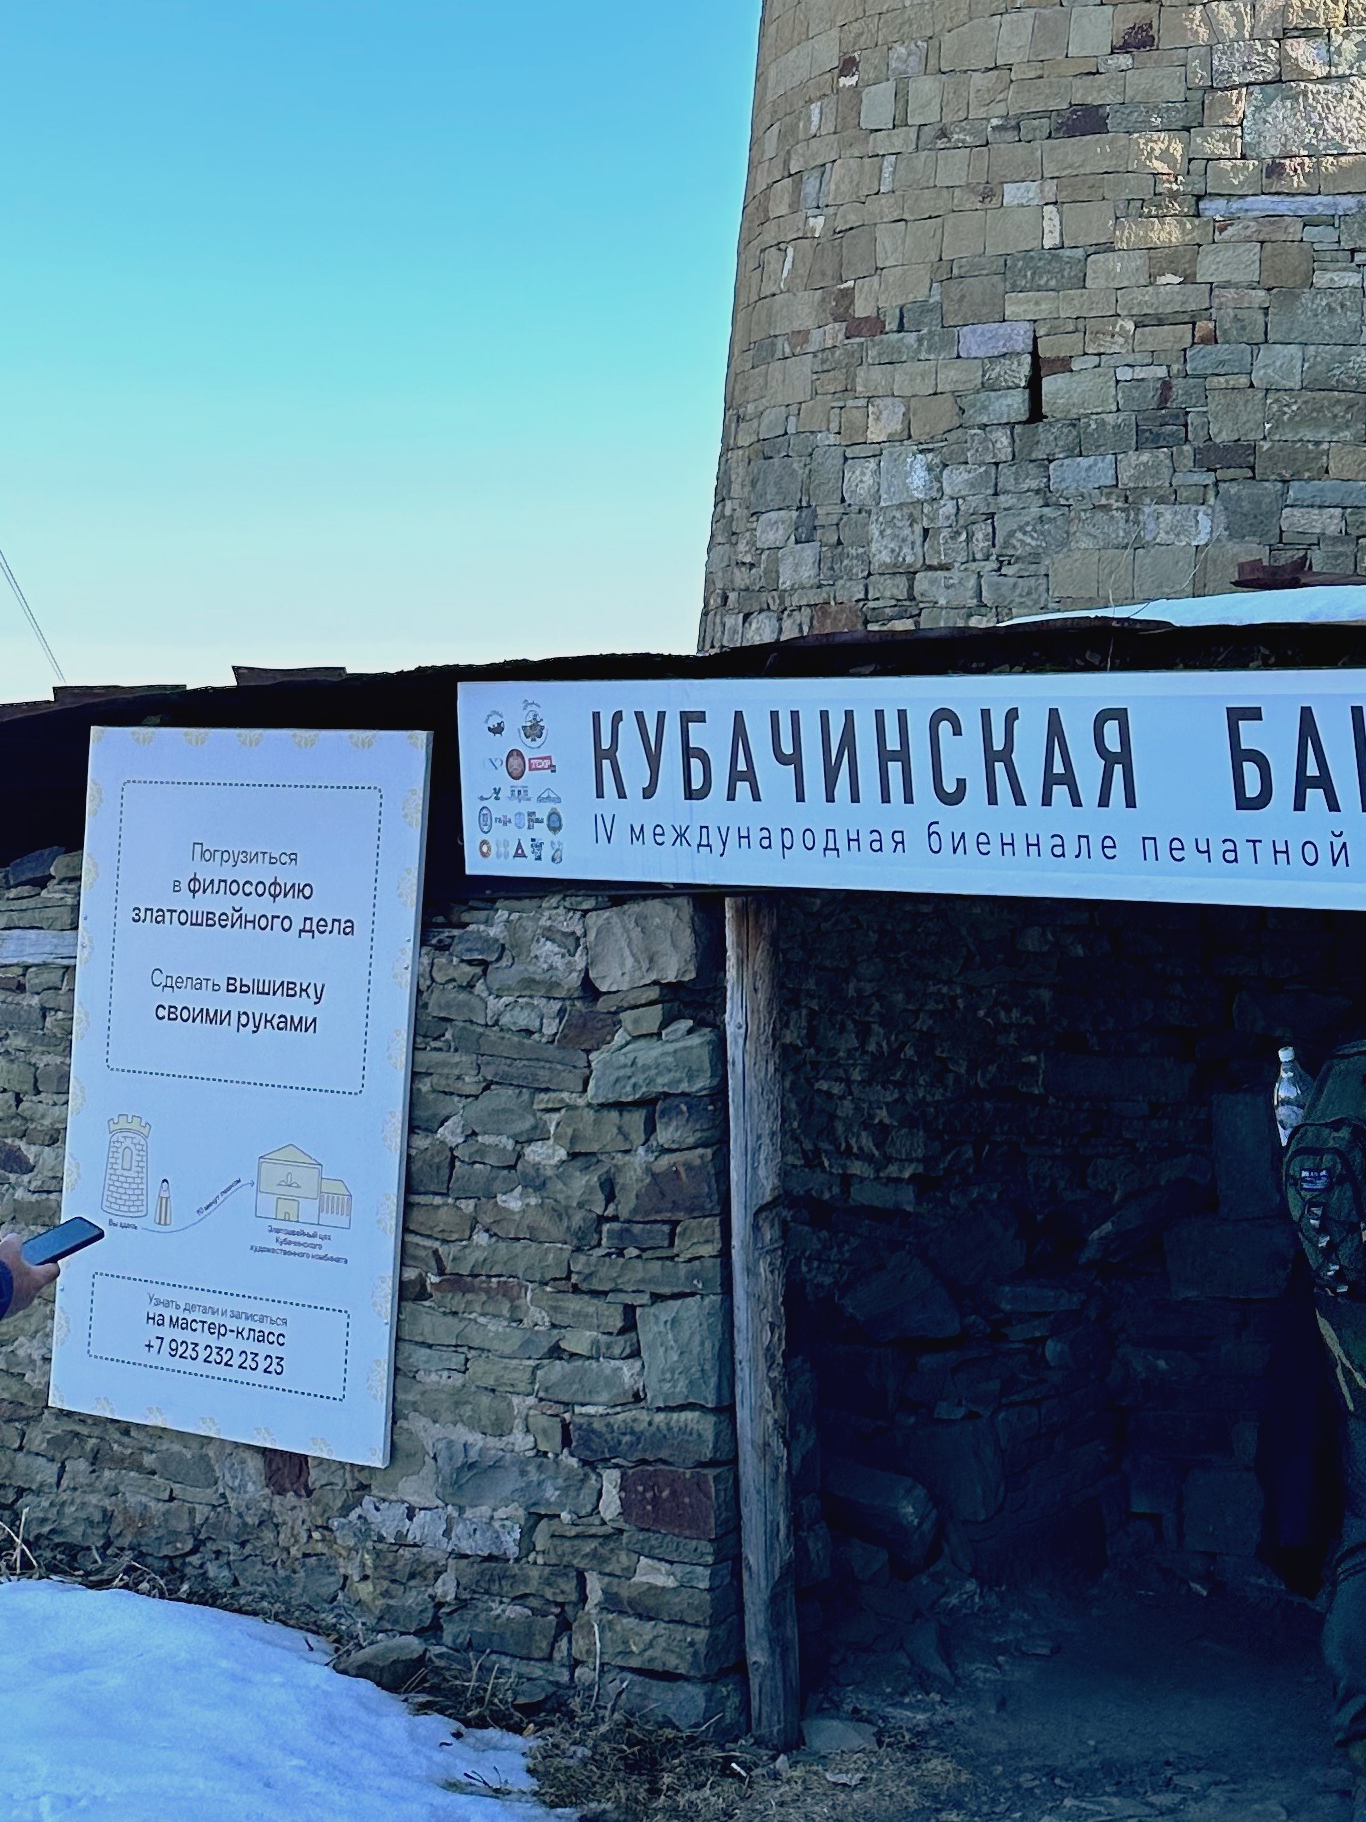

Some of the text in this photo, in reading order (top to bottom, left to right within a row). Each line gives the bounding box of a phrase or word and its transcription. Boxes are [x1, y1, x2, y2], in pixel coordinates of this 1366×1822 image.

[591, 707, 1137, 809] КУБАЧИНСКАЯ
[191, 841, 298, 867] Погрузиться
[593, 814, 616, 844] IV
[628, 817, 907, 861] международная
[927, 820, 1118, 861] биеннале
[1141, 829, 1351, 869] печатной
[172, 872, 314, 903] в философию
[131, 906, 356, 940] златошвейного дела
[150, 967, 326, 1005] Сделать вышивку
[154, 1003, 318, 1034] своими руками
[146, 1291, 181, 1311] Узнать
[182, 1301, 220, 1317] детали
[229, 1308, 288, 1327] записаться
[145, 1311, 286, 1347] на мастер-класс
[144, 1335, 285, 1376] +7 923 232 23 23
